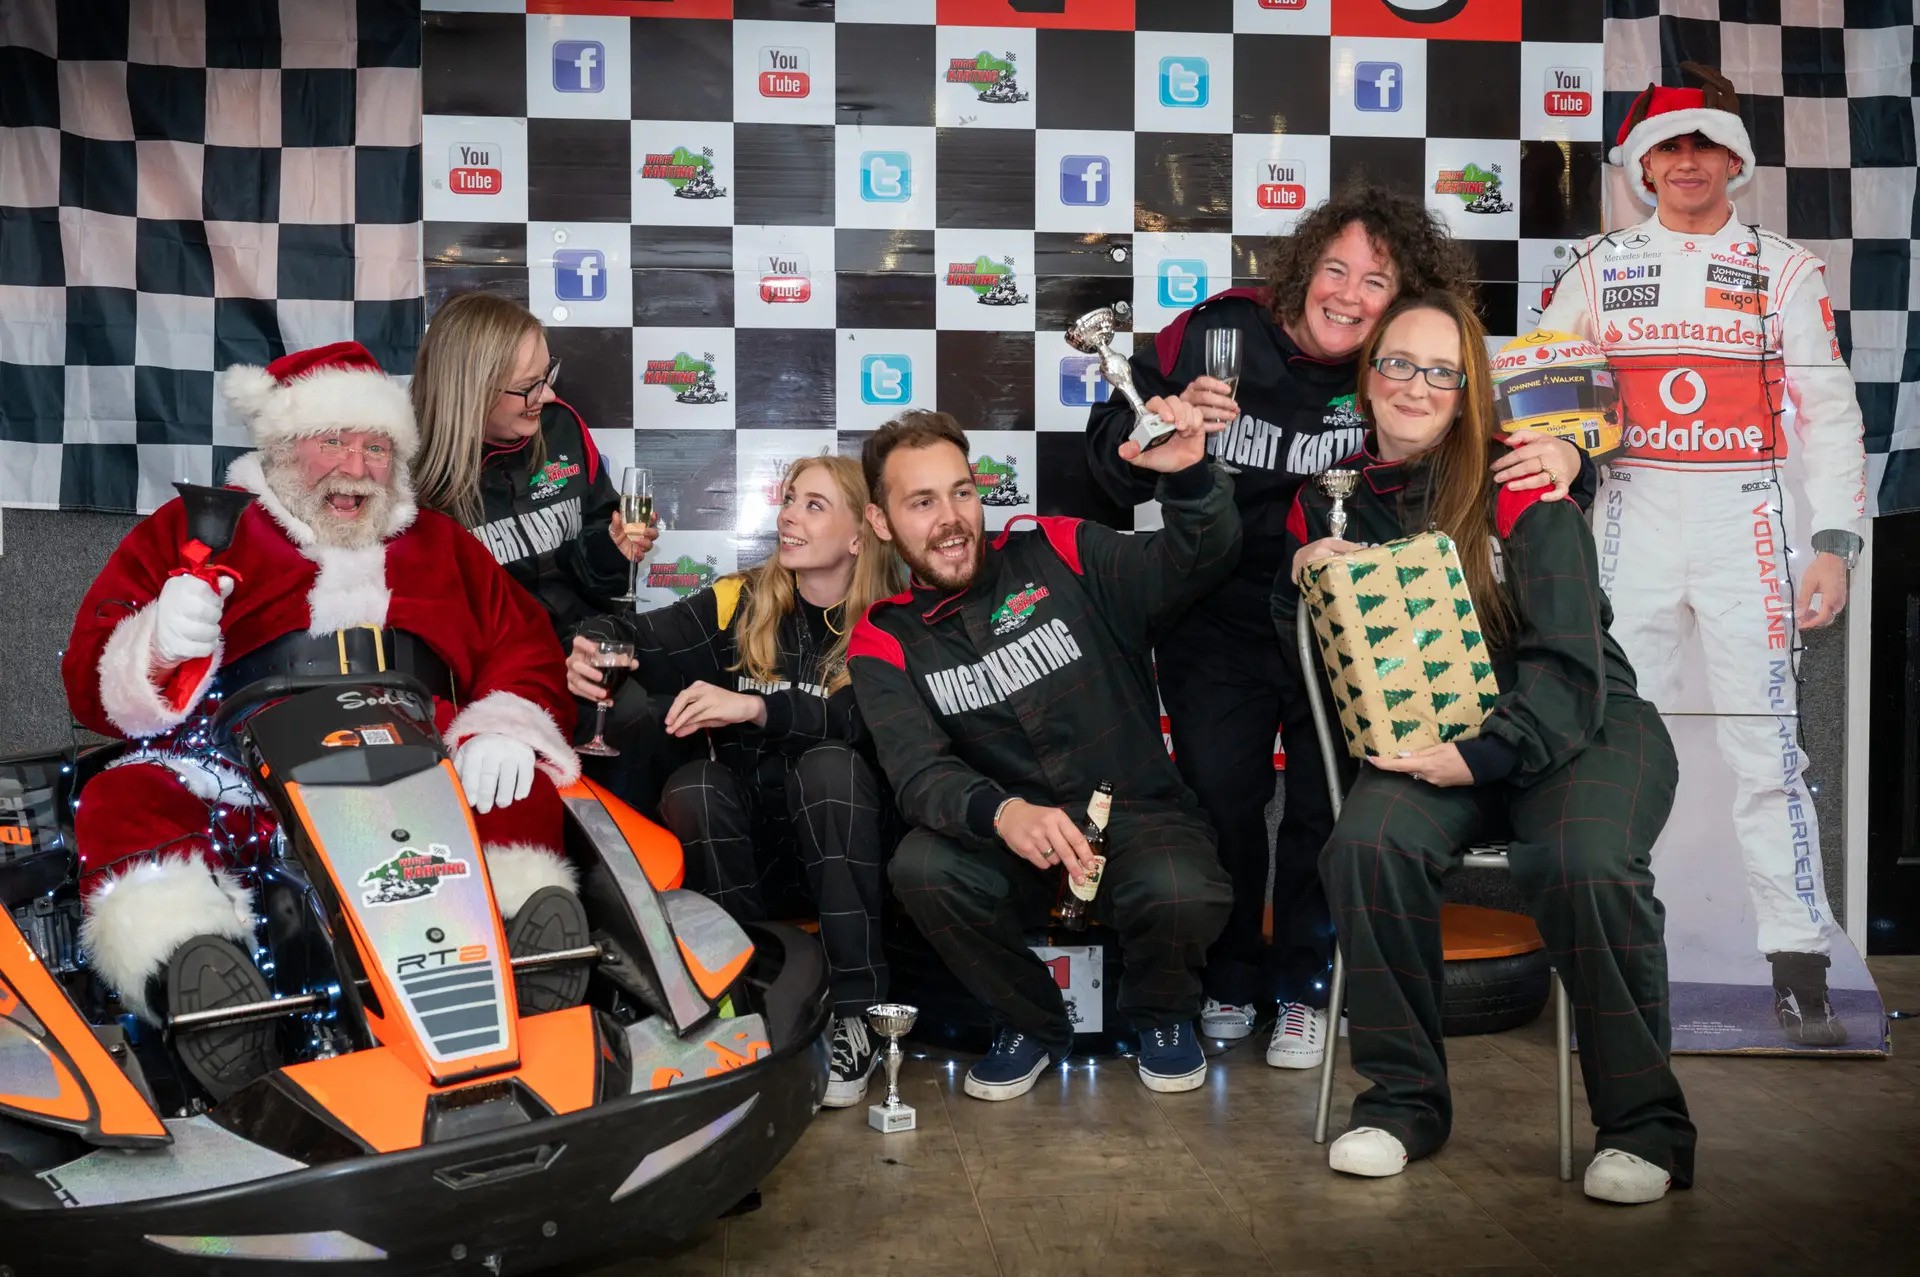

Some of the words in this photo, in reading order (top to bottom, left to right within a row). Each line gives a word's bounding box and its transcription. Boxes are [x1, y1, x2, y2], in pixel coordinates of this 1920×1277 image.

[769, 51, 798, 71] You
[767, 75, 800, 94] Tube
[947, 69, 999, 82] KARTING
[1555, 71, 1581, 90] You
[1552, 94, 1583, 112] Tube
[460, 147, 489, 166] You
[646, 154, 674, 164] WIGHT
[458, 171, 492, 190] Tube
[642, 165, 696, 179] KARTING
[1267, 164, 1294, 182] You
[1265, 187, 1297, 205] Tube
[1435, 181, 1485, 194] KARTING
[769, 256, 798, 274] You
[1711, 253, 1771, 272] vodafone
[947, 274, 1000, 286] KARTING
[1603, 265, 1645, 282] Mobil
[1712, 266, 1753, 281] JOHNNIE
[1713, 274, 1753, 287] WALKER
[1604, 286, 1656, 305] BOSS
[1721, 291, 1753, 309] aigo
[1628, 317, 1767, 348] Santander
[648, 360, 676, 371] WIGHT
[644, 371, 697, 384] KARTING
[1507, 379, 1542, 394] JOHNNIE
[1550, 375, 1585, 384] WALKER
[548, 464, 581, 482] KARTING
[647, 574, 700, 587] KARTING
[1752, 501, 1788, 650] VODAFONE
[398, 856, 432, 866] WIGHT
[404, 862, 467, 880] KARTING
[397, 945, 488, 974] RT8
